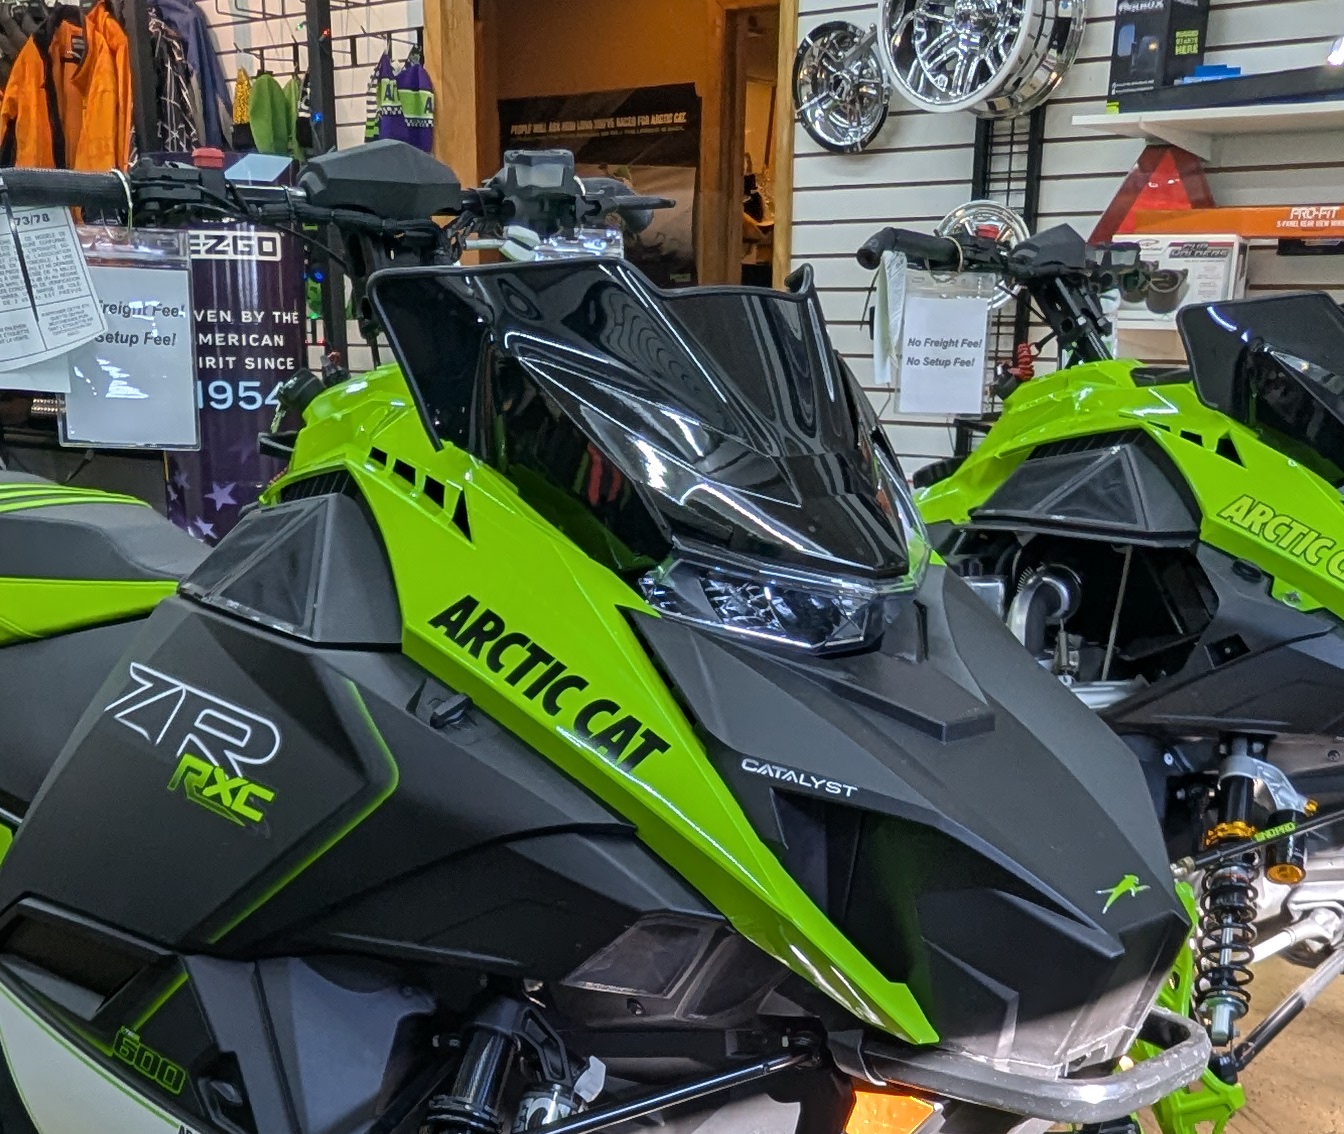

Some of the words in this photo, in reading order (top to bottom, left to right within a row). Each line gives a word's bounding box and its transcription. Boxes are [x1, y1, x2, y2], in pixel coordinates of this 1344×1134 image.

[14, 213, 51, 226] 73/78
[1289, 206, 1340, 219] PRO-FIT
[100, 300, 156, 319] reight
[194, 310, 231, 323] VEN
[242, 311, 264, 323] BY
[272, 311, 299, 324] THE
[144, 332, 176, 347] Fee!
[198, 333, 285, 346] MERICAN
[907, 338, 921, 347] No
[924, 338, 959, 350] Freight
[960, 339, 983, 348] Fee!
[198, 356, 237, 369] IRIT
[245, 357, 295, 370] SINCE
[906, 357, 920, 366] No
[923, 357, 951, 368] Setup
[953, 358, 975, 367] Fee!
[1216, 493, 1336, 566] ARCTIC
[427, 595, 590, 717] ARCTIC
[573, 698, 672, 773] CAT
[104, 662, 281, 778] ZR
[741, 758, 858, 797] CATALYST
[167, 753, 276, 827] RXC
[113, 1028, 187, 1095] 600
